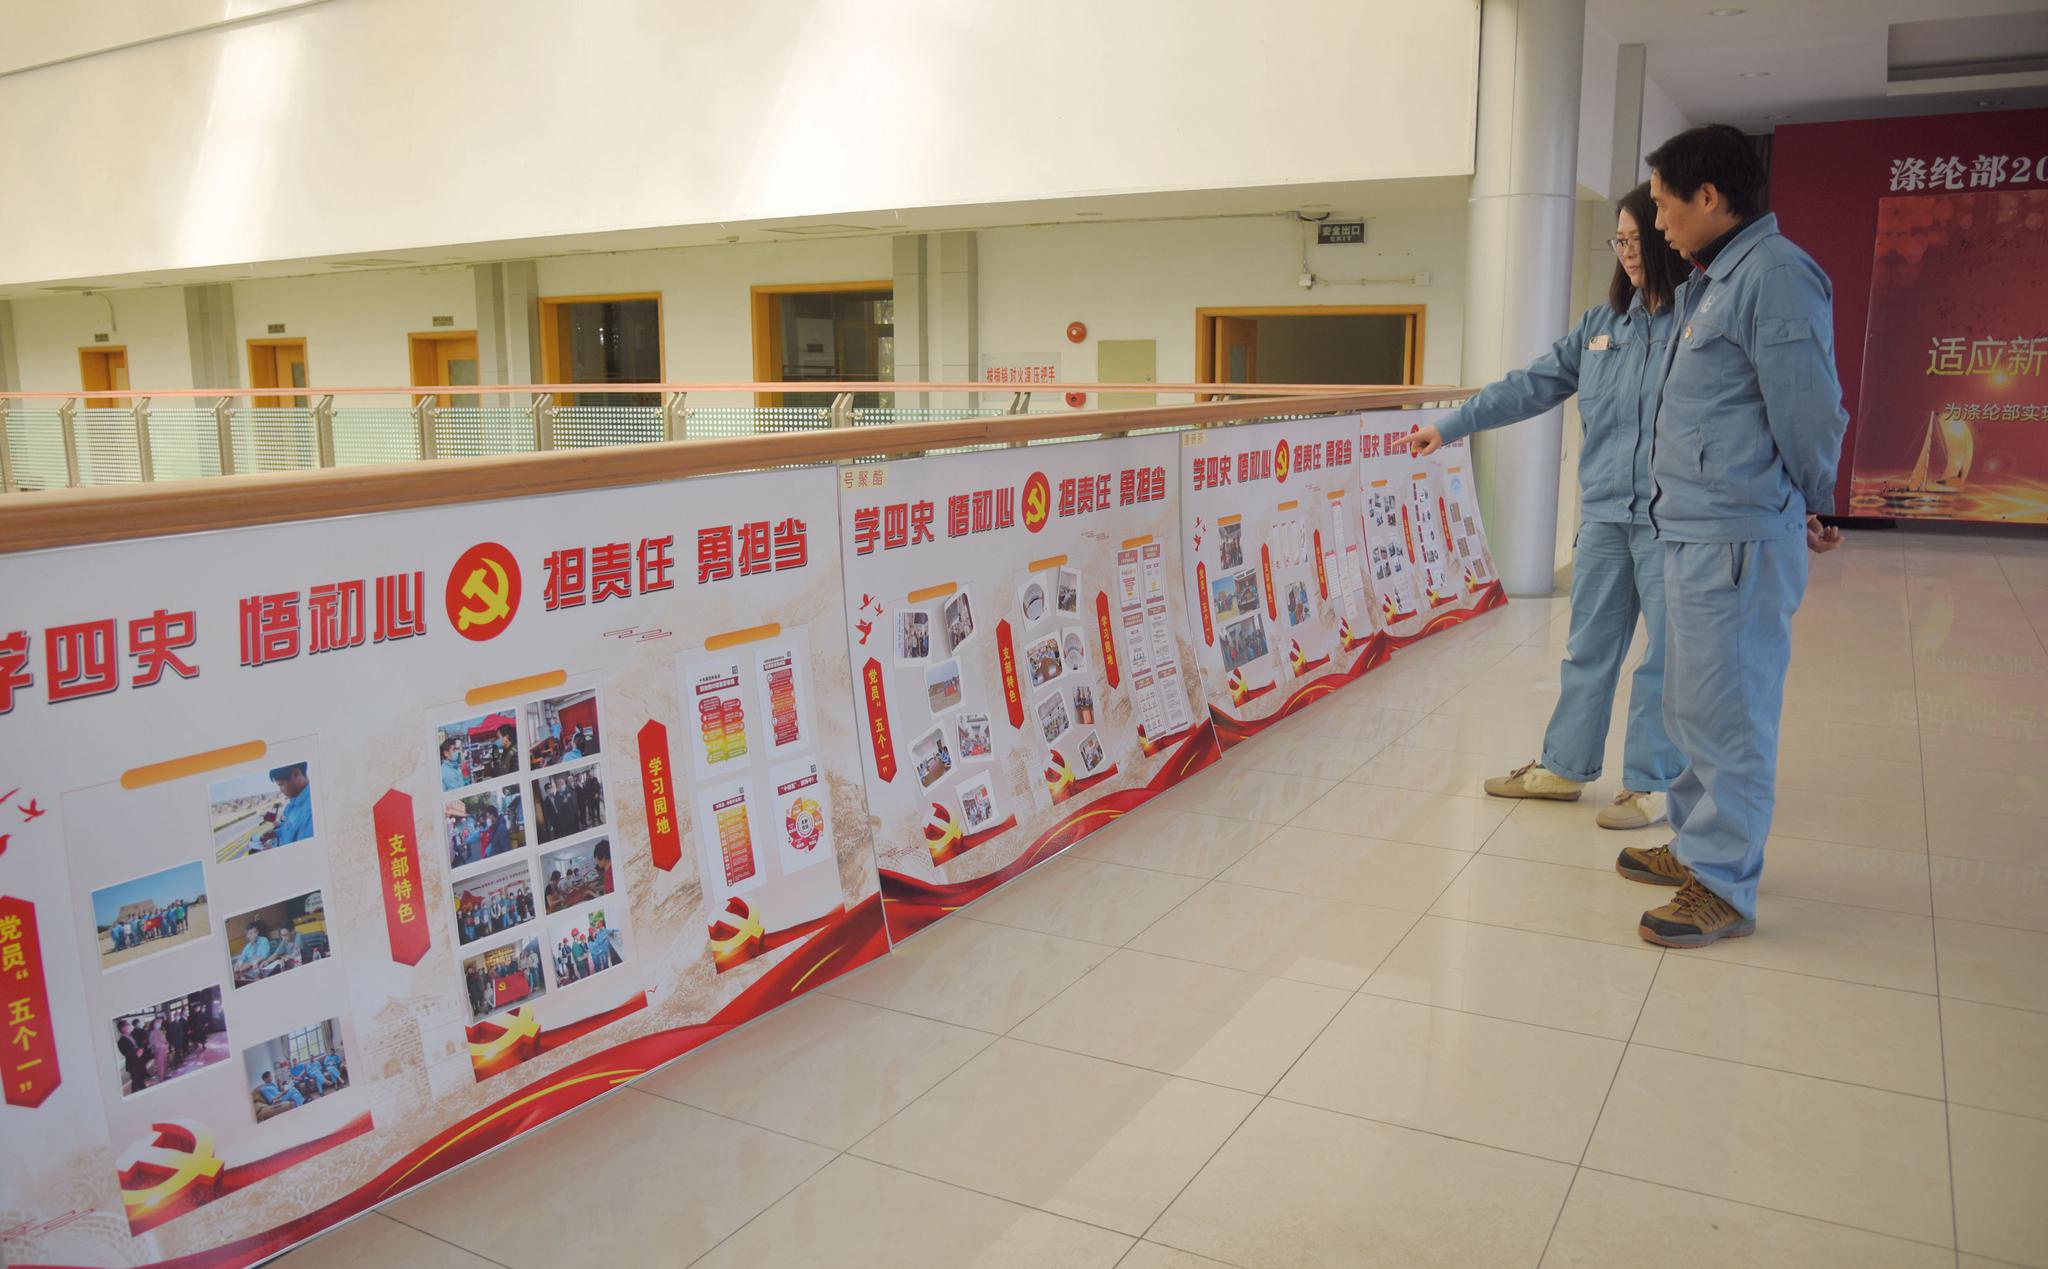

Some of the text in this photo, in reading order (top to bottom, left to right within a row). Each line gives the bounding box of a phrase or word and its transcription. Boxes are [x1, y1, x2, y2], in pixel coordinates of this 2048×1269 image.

[1926, 335, 2048, 377] 适应新
[1193, 455, 1232, 491] 学四史
[1237, 449, 1272, 483] 悟初心
[1293, 442, 1322, 473] 担责任
[1360, 433, 1380, 458] 四史
[854, 465, 1166, 556] 学四史 悟初心 担责任 勇担当
[239, 570, 428, 668] 悟初心
[543, 534, 675, 612] 担责任
[697, 517, 808, 584] 勇担当
[648, 756, 671, 835] 学习园地
[388, 833, 416, 924] 支部特色
